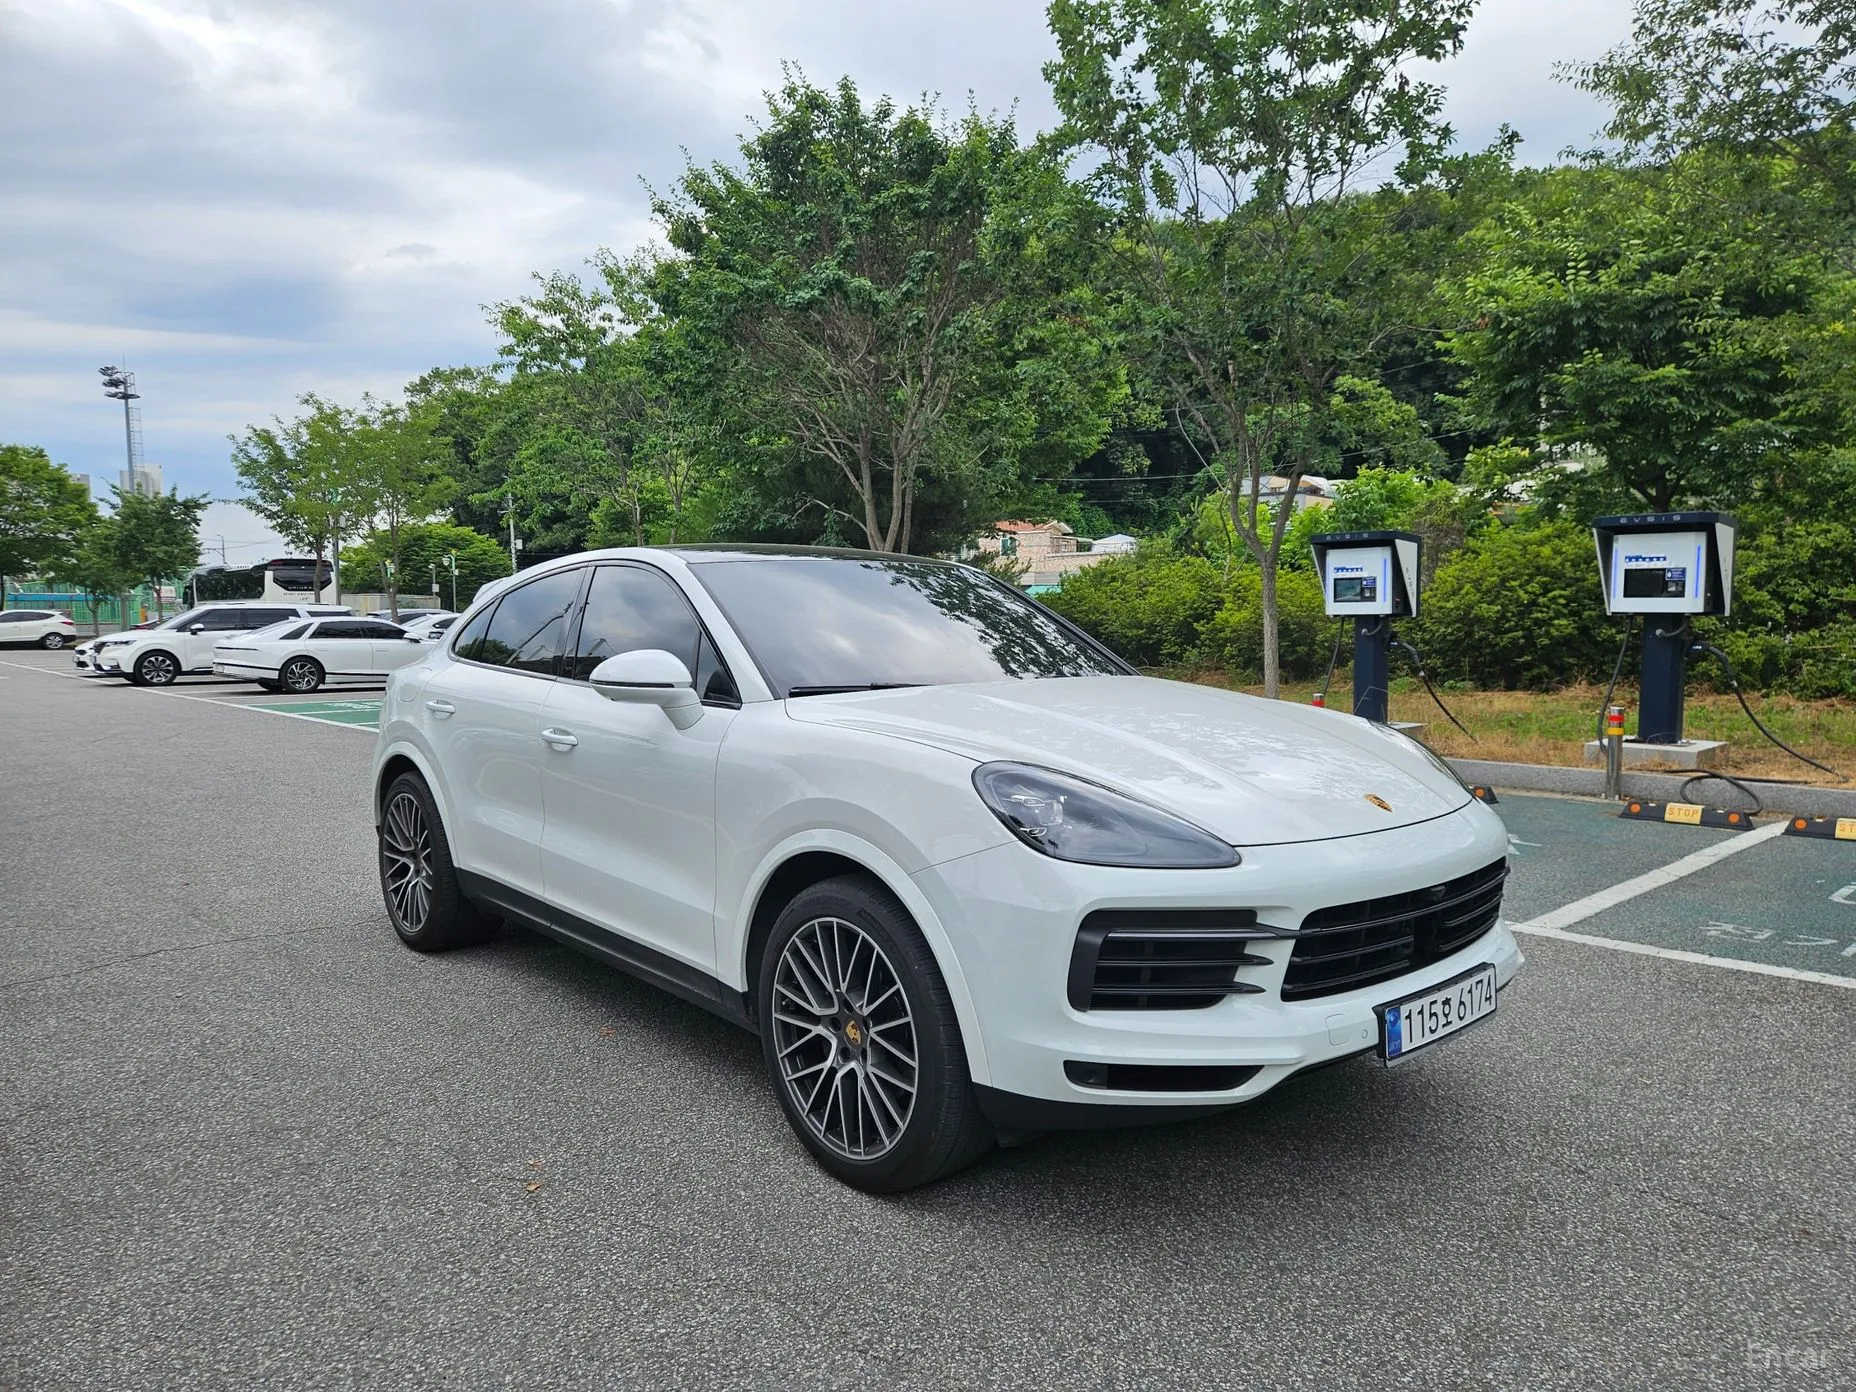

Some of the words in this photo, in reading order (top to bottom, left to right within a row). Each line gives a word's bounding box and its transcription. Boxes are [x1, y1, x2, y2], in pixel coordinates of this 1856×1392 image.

[1668, 807, 1699, 817] STOP
[1404, 996, 1453, 1044] 115호
[1457, 974, 1493, 1022] 6174
